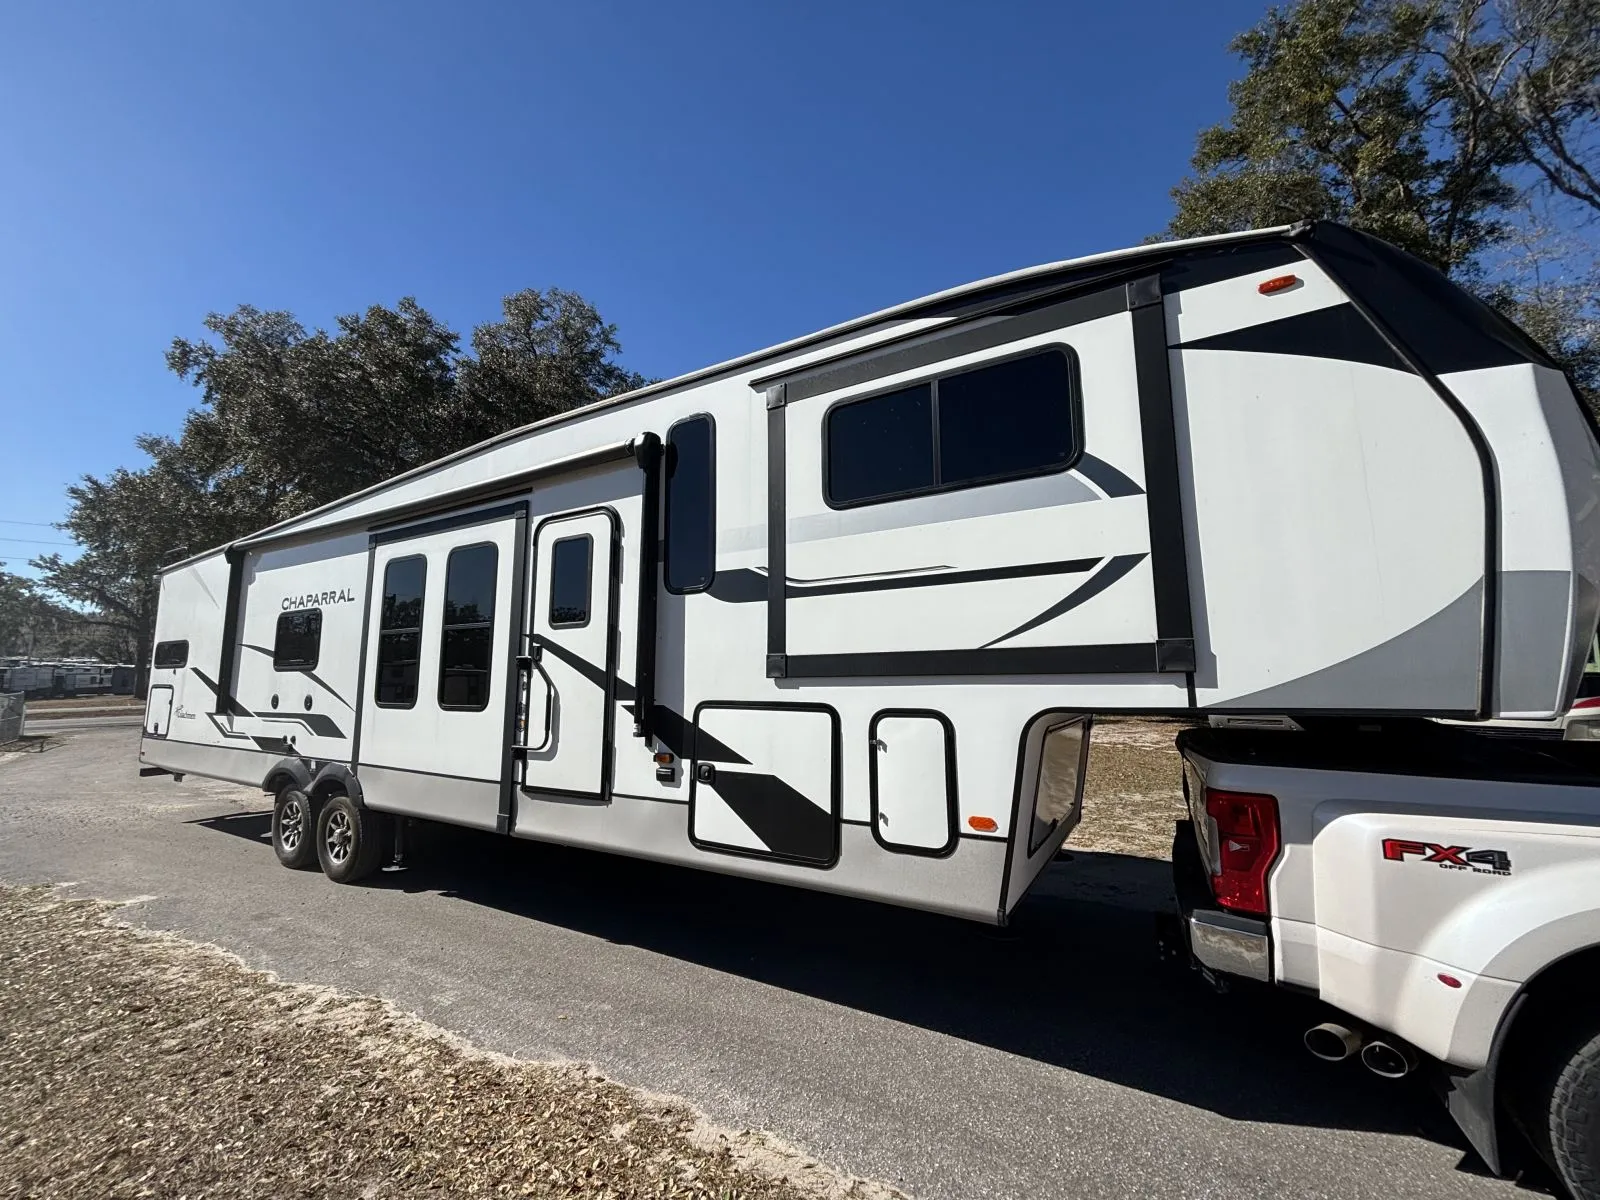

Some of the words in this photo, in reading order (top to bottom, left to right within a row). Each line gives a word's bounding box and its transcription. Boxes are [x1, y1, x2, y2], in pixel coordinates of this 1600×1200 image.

[281, 588, 355, 611] CHAPARRAL
[1382, 838, 1512, 872] FX4
[1439, 863, 1468, 871] OFF
[1472, 867, 1512, 876] ROAD
